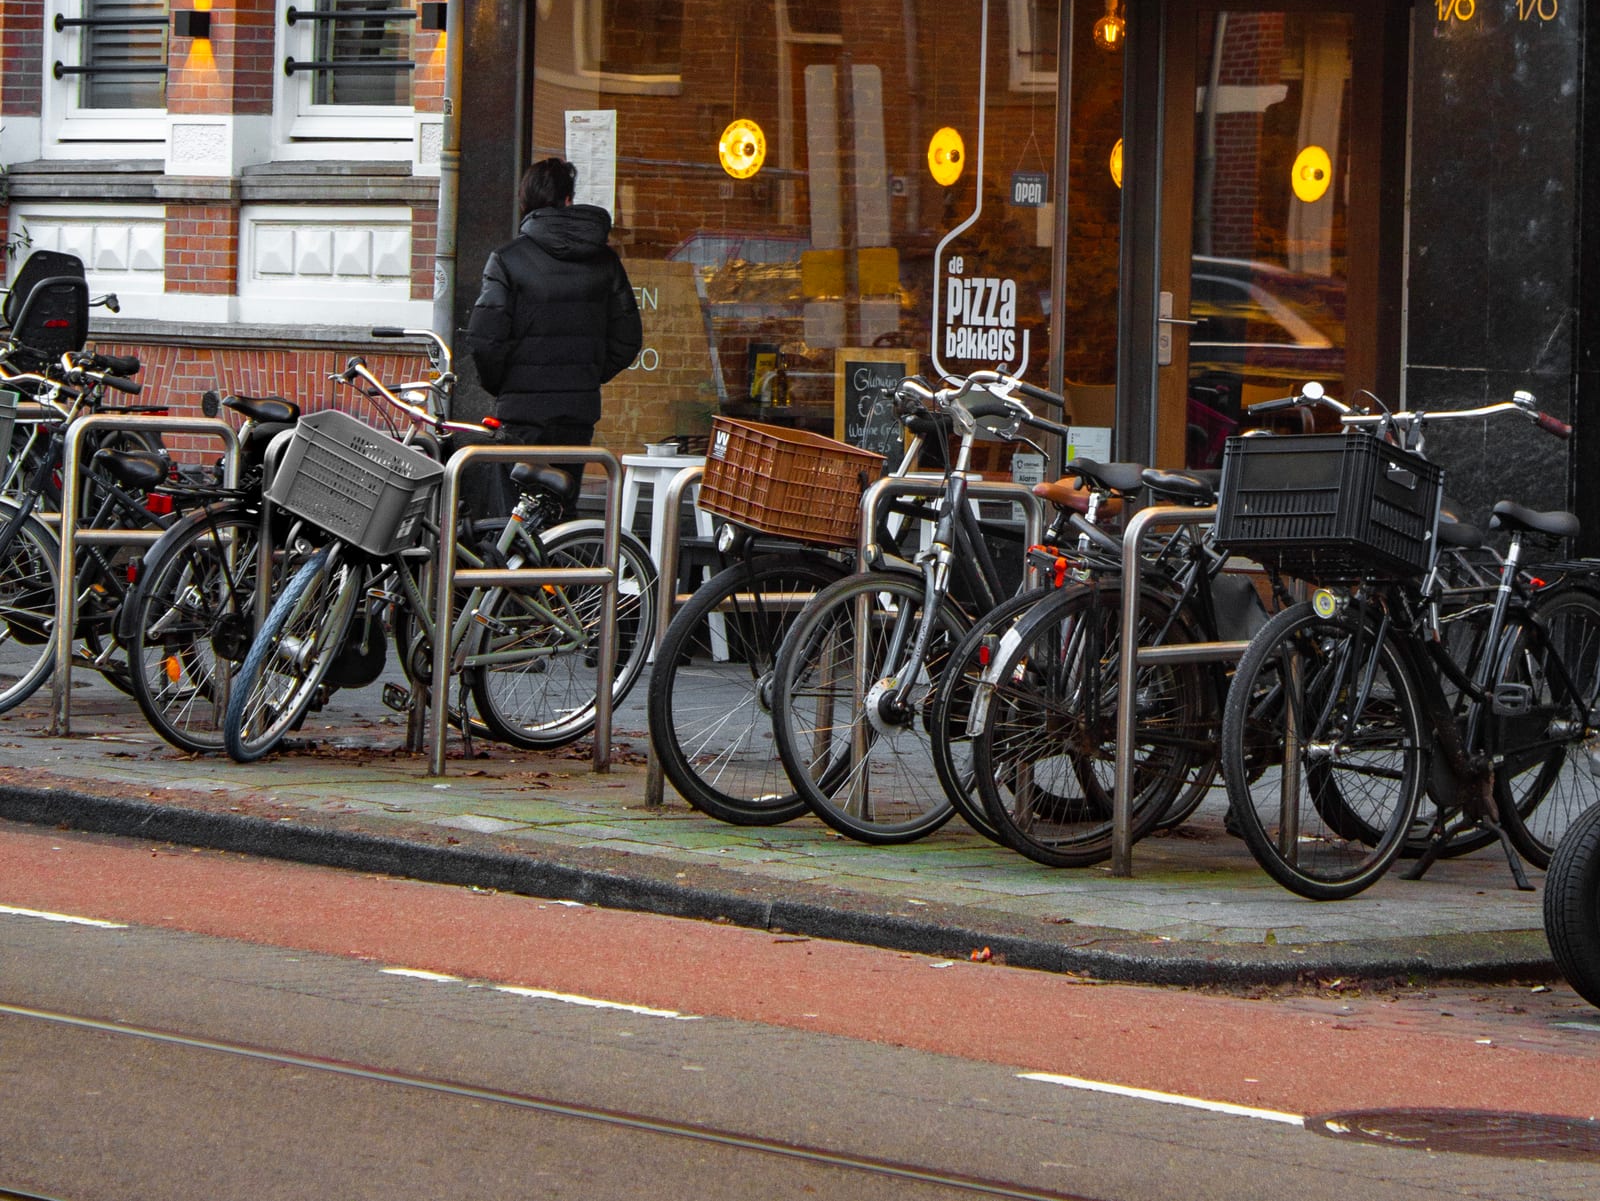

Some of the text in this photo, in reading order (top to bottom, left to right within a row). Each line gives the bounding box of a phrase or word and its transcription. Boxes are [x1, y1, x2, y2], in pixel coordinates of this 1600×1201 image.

[948, 256, 964, 275] de
[945, 326, 1016, 361] bakkers
[716, 430, 730, 447] W
